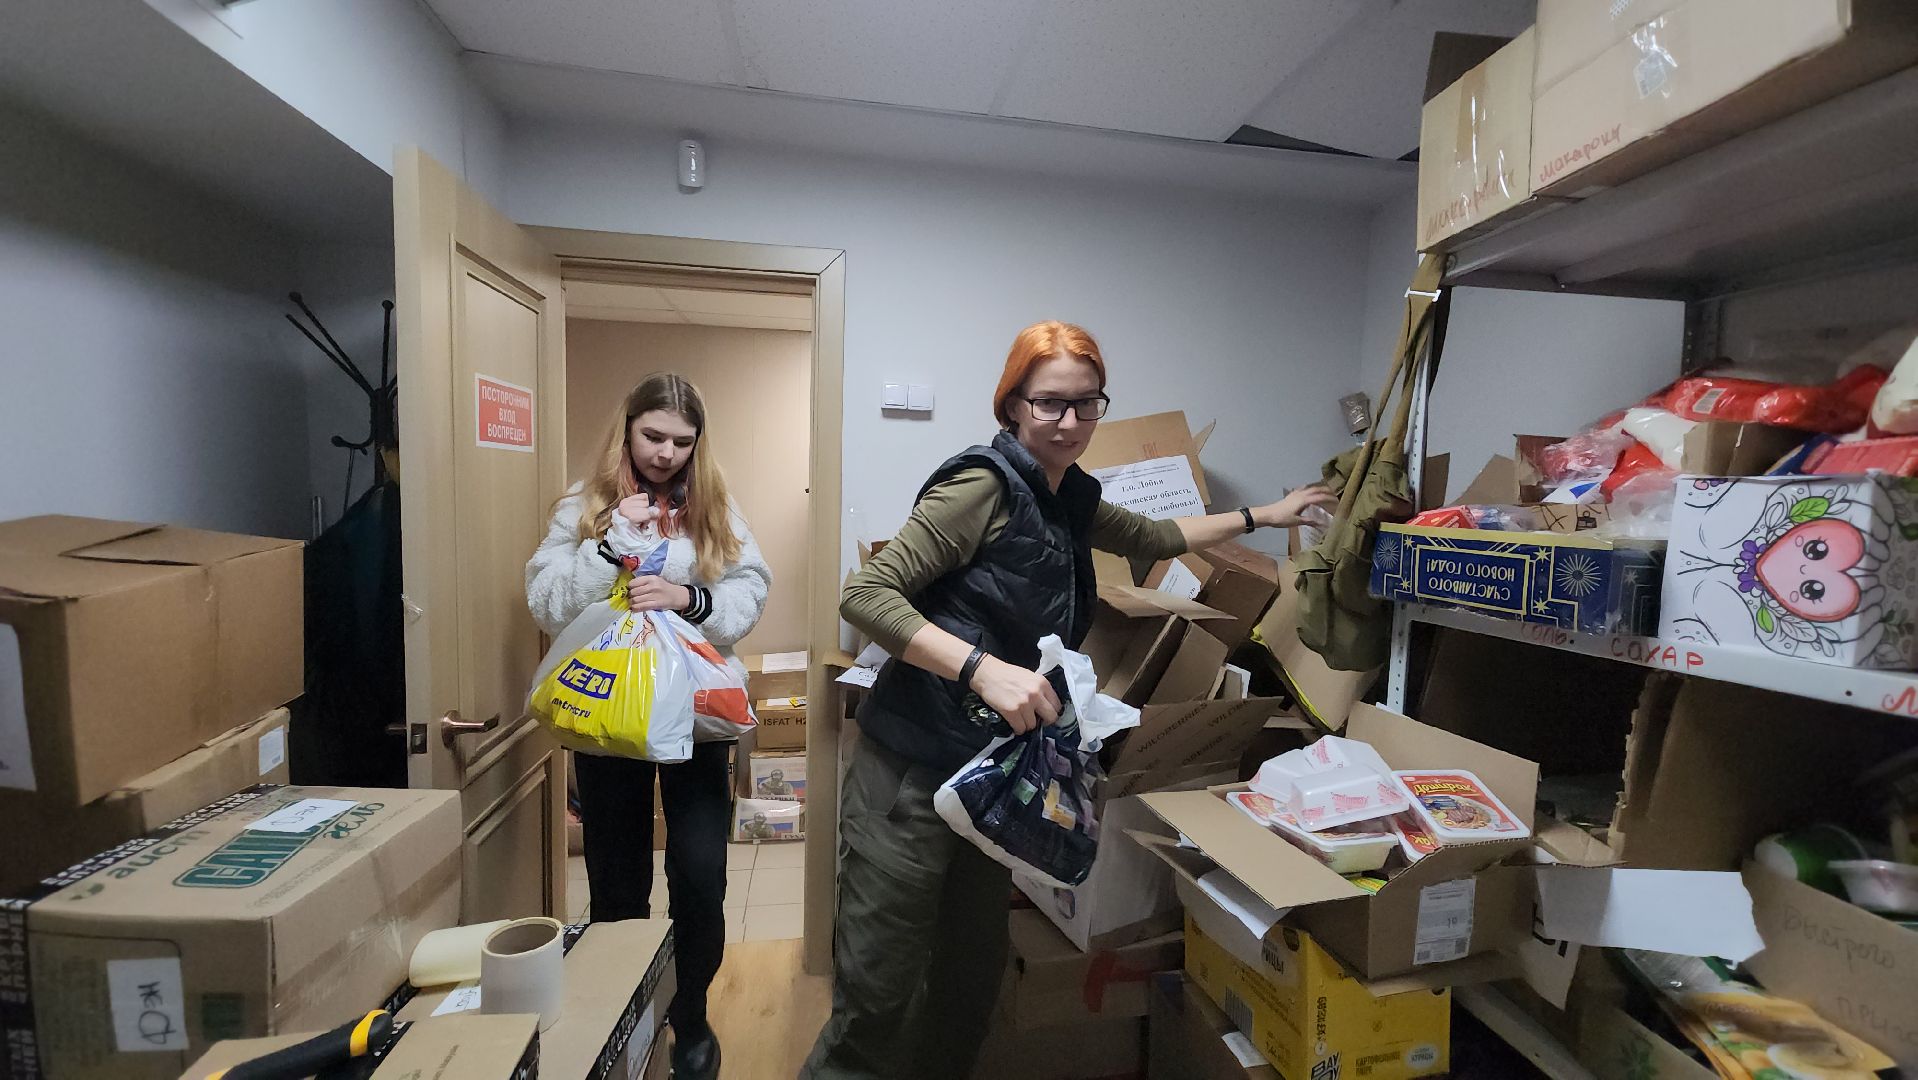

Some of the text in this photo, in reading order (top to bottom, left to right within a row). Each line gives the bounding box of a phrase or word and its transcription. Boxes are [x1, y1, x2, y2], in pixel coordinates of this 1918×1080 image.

[498, 407, 517, 425] ВХОД
[1426, 558, 1515, 582] НОВОГО ГОДА!
[1428, 576, 1511, 601] СЧАСТЛИВОГО
